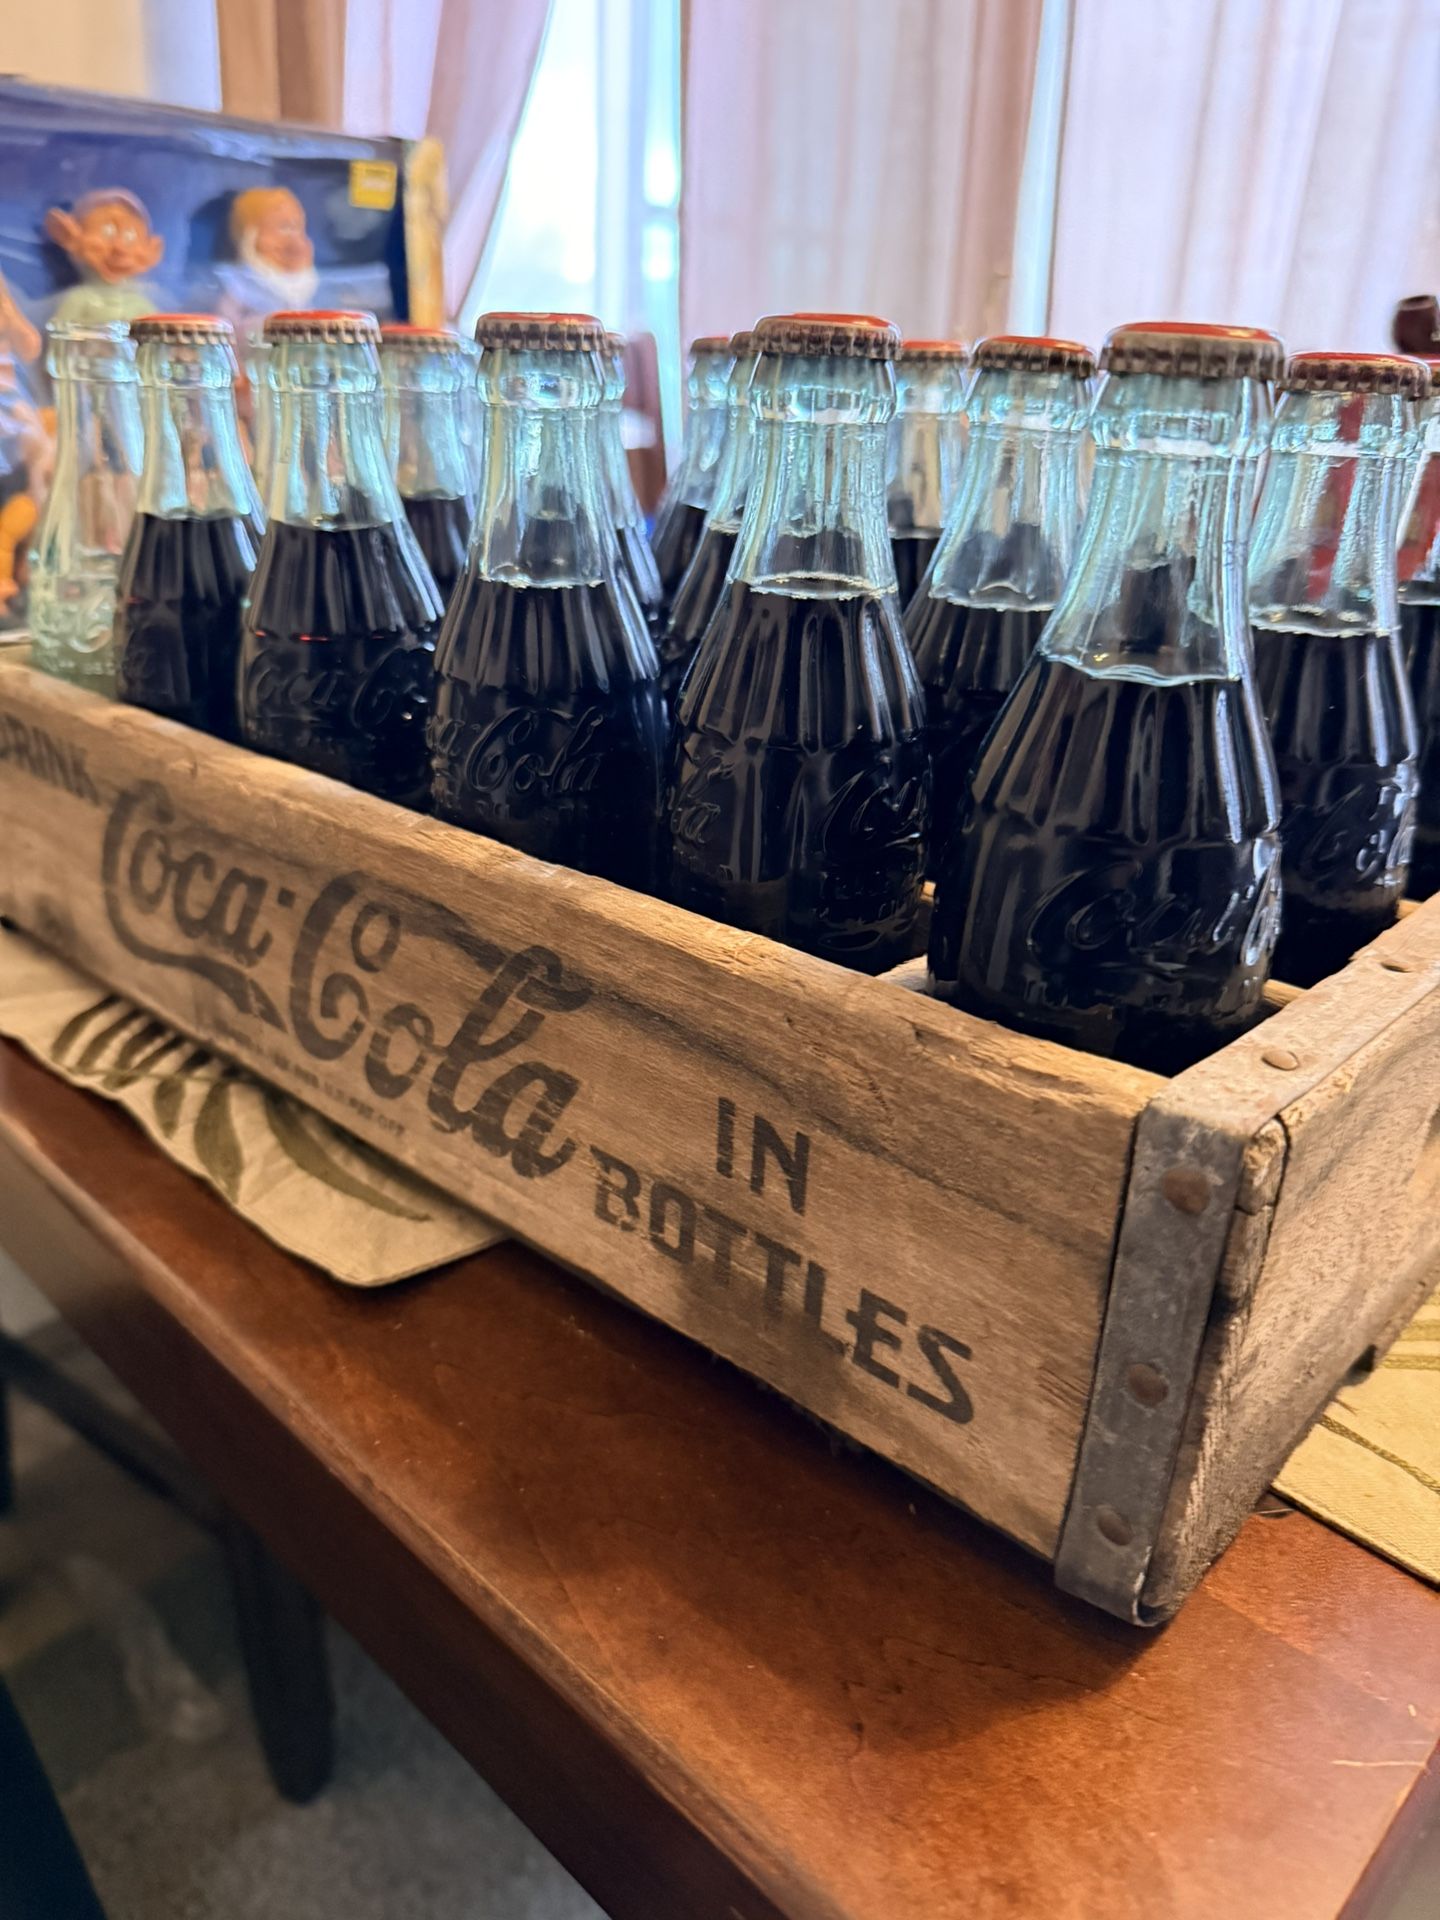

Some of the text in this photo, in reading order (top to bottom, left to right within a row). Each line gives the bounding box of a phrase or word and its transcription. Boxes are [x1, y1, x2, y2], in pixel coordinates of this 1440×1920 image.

[102, 778, 600, 1180] Coca-Cola
[589, 1144, 975, 1425] BOTTLES
[716, 1096, 811, 1217] IN
